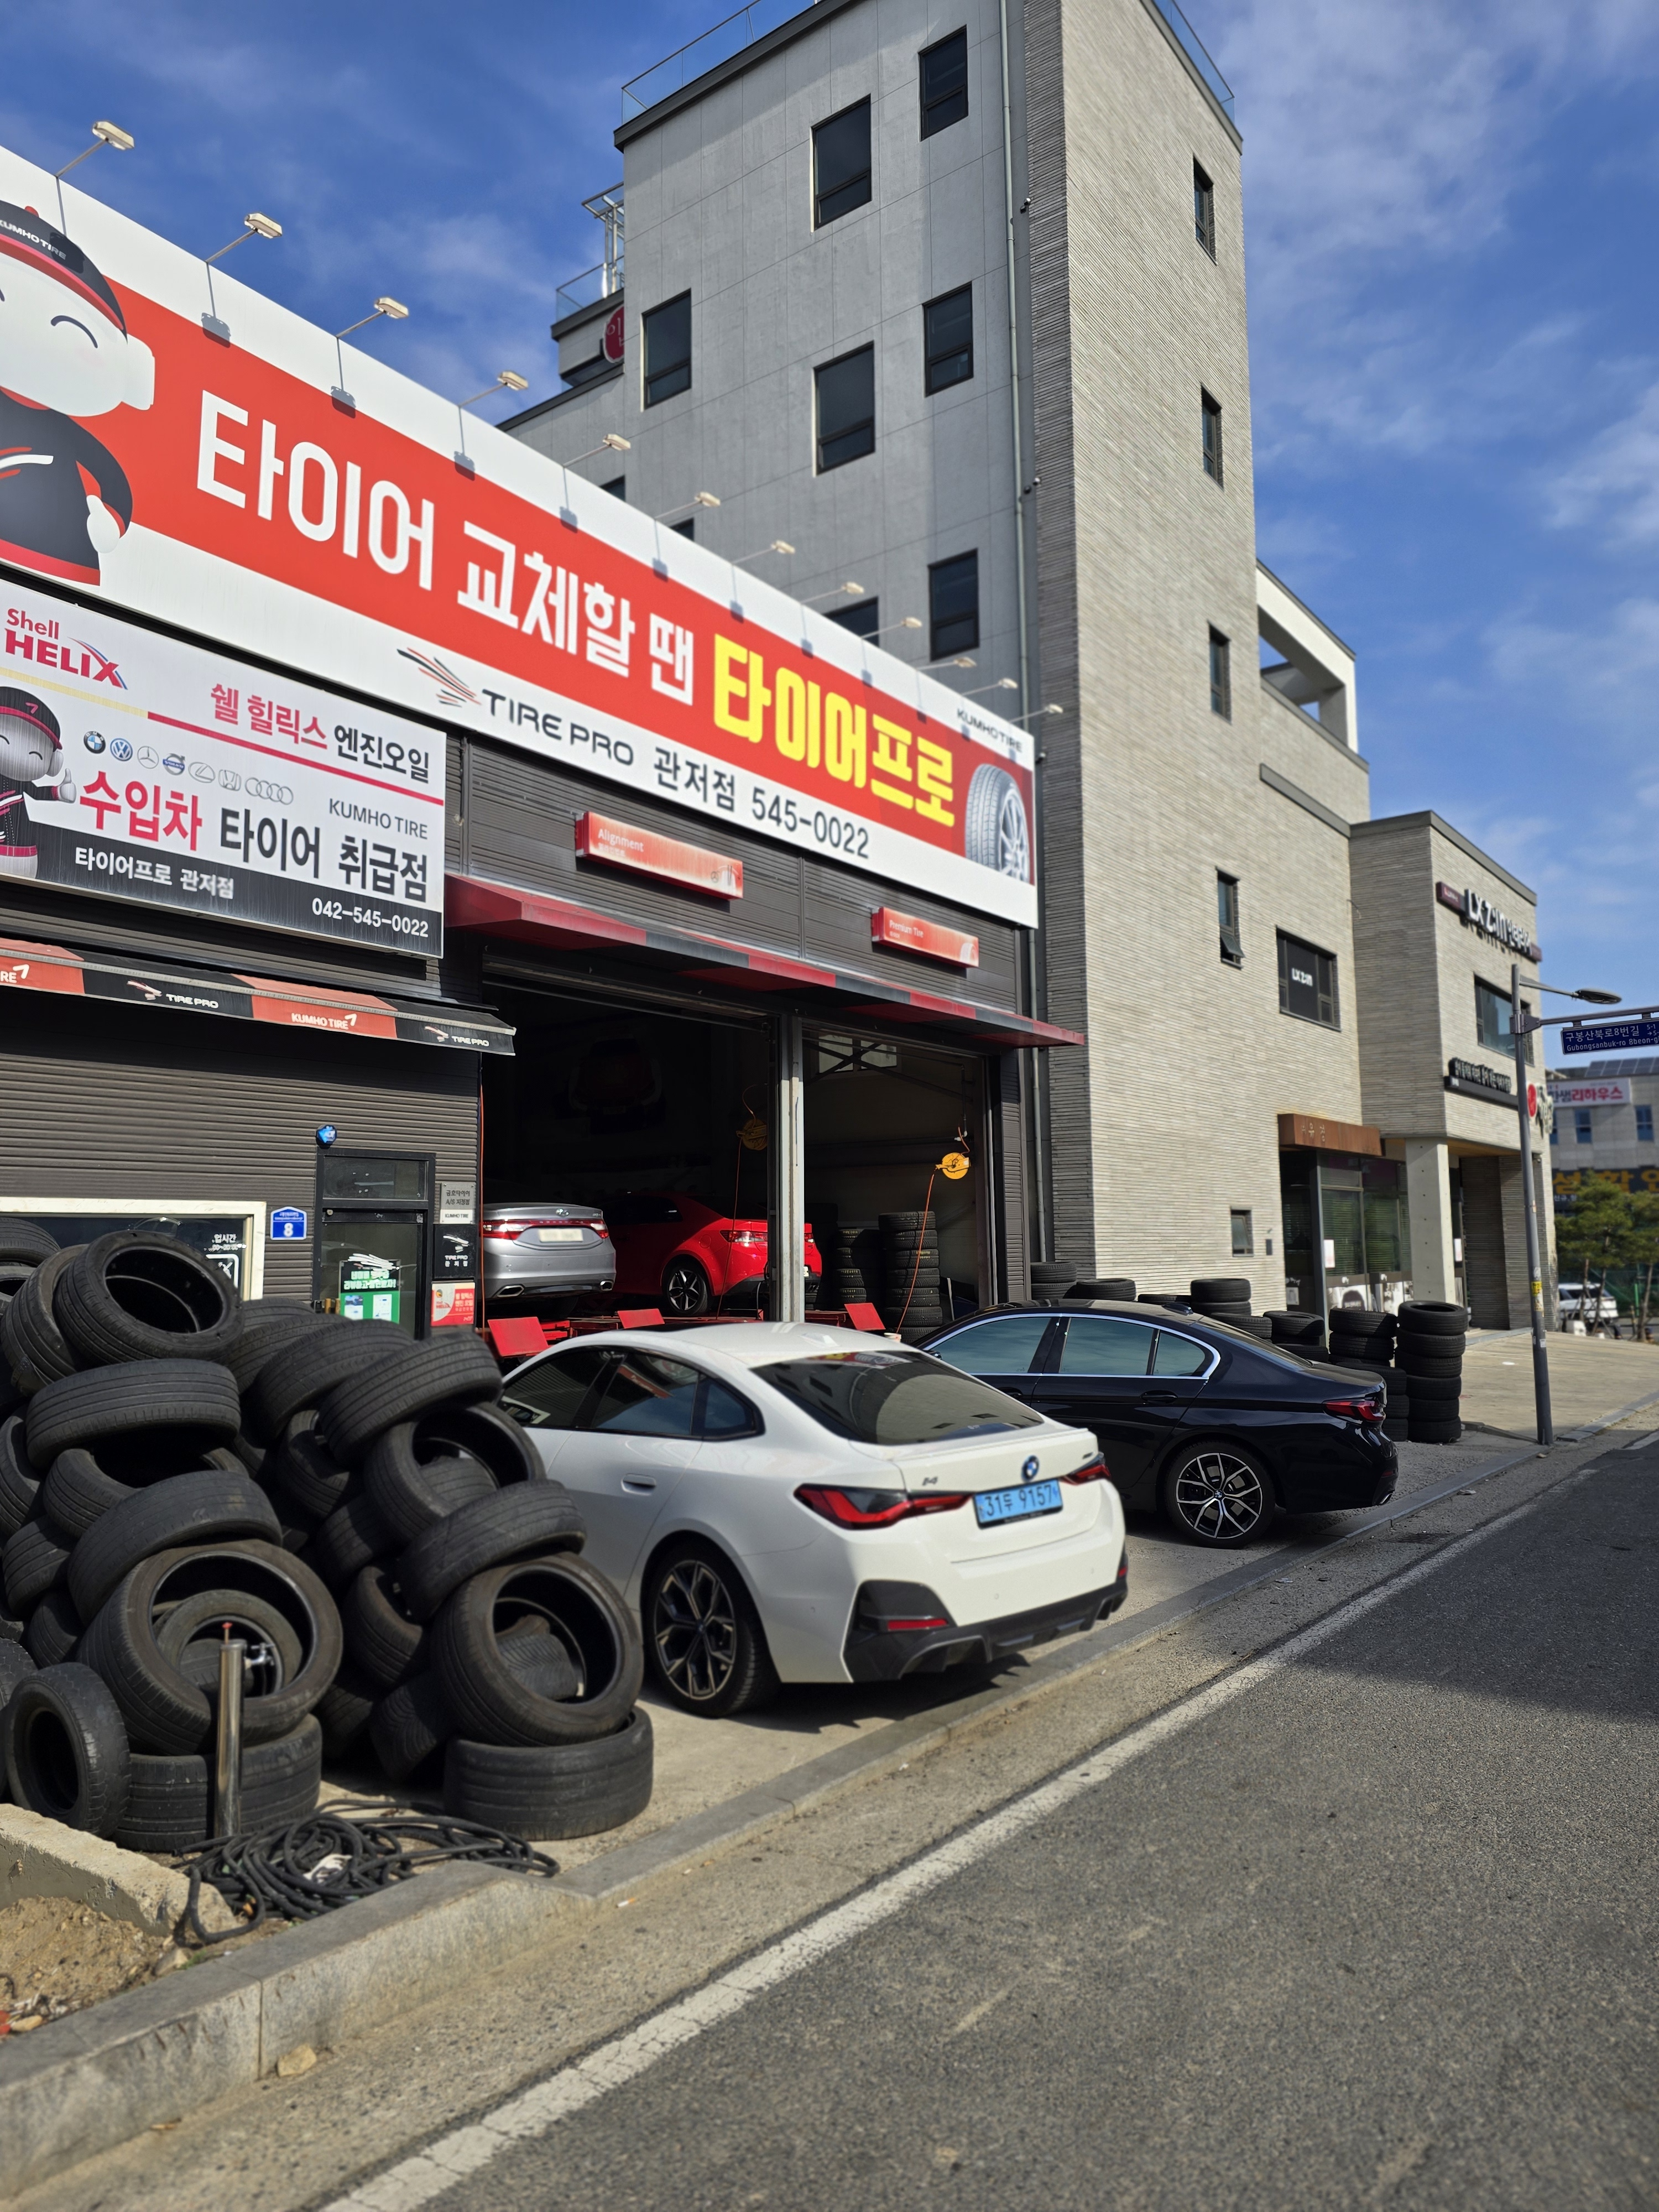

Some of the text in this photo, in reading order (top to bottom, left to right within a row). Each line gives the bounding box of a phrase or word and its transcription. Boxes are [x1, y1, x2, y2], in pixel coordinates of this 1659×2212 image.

[7, 608, 60, 640] Shell
[197, 390, 955, 827] 타이어 교체할 땐 타이어프로
[4, 628, 128, 690] HELIX
[211, 683, 429, 784] 쉘 힐릭스 엔진오일
[482, 688, 634, 766] TIRE PRO
[329, 798, 428, 840] KUMHO TIRE
[654, 746, 869, 859] 관저점 545-0022
[80, 771, 427, 903] 수입차 타이어 취급점
[598, 828, 644, 853] Alignment
[75, 847, 234, 900] 타이어프로 관저점
[311, 897, 429, 937] 042-545-0022
[166, 993, 218, 1008] TIRE PRO
[451, 1035, 489, 1047] TIRE PRO
[1565, 1025, 1640, 1042] 구봉산북로8번길
[1567, 1040, 1626, 1051] Gubongsanbuk-ro
[212, 1234, 237, 1244] 업시간
[284, 1223, 294, 1237] 8
[984, 1484, 1051, 1516] 31두 9157
